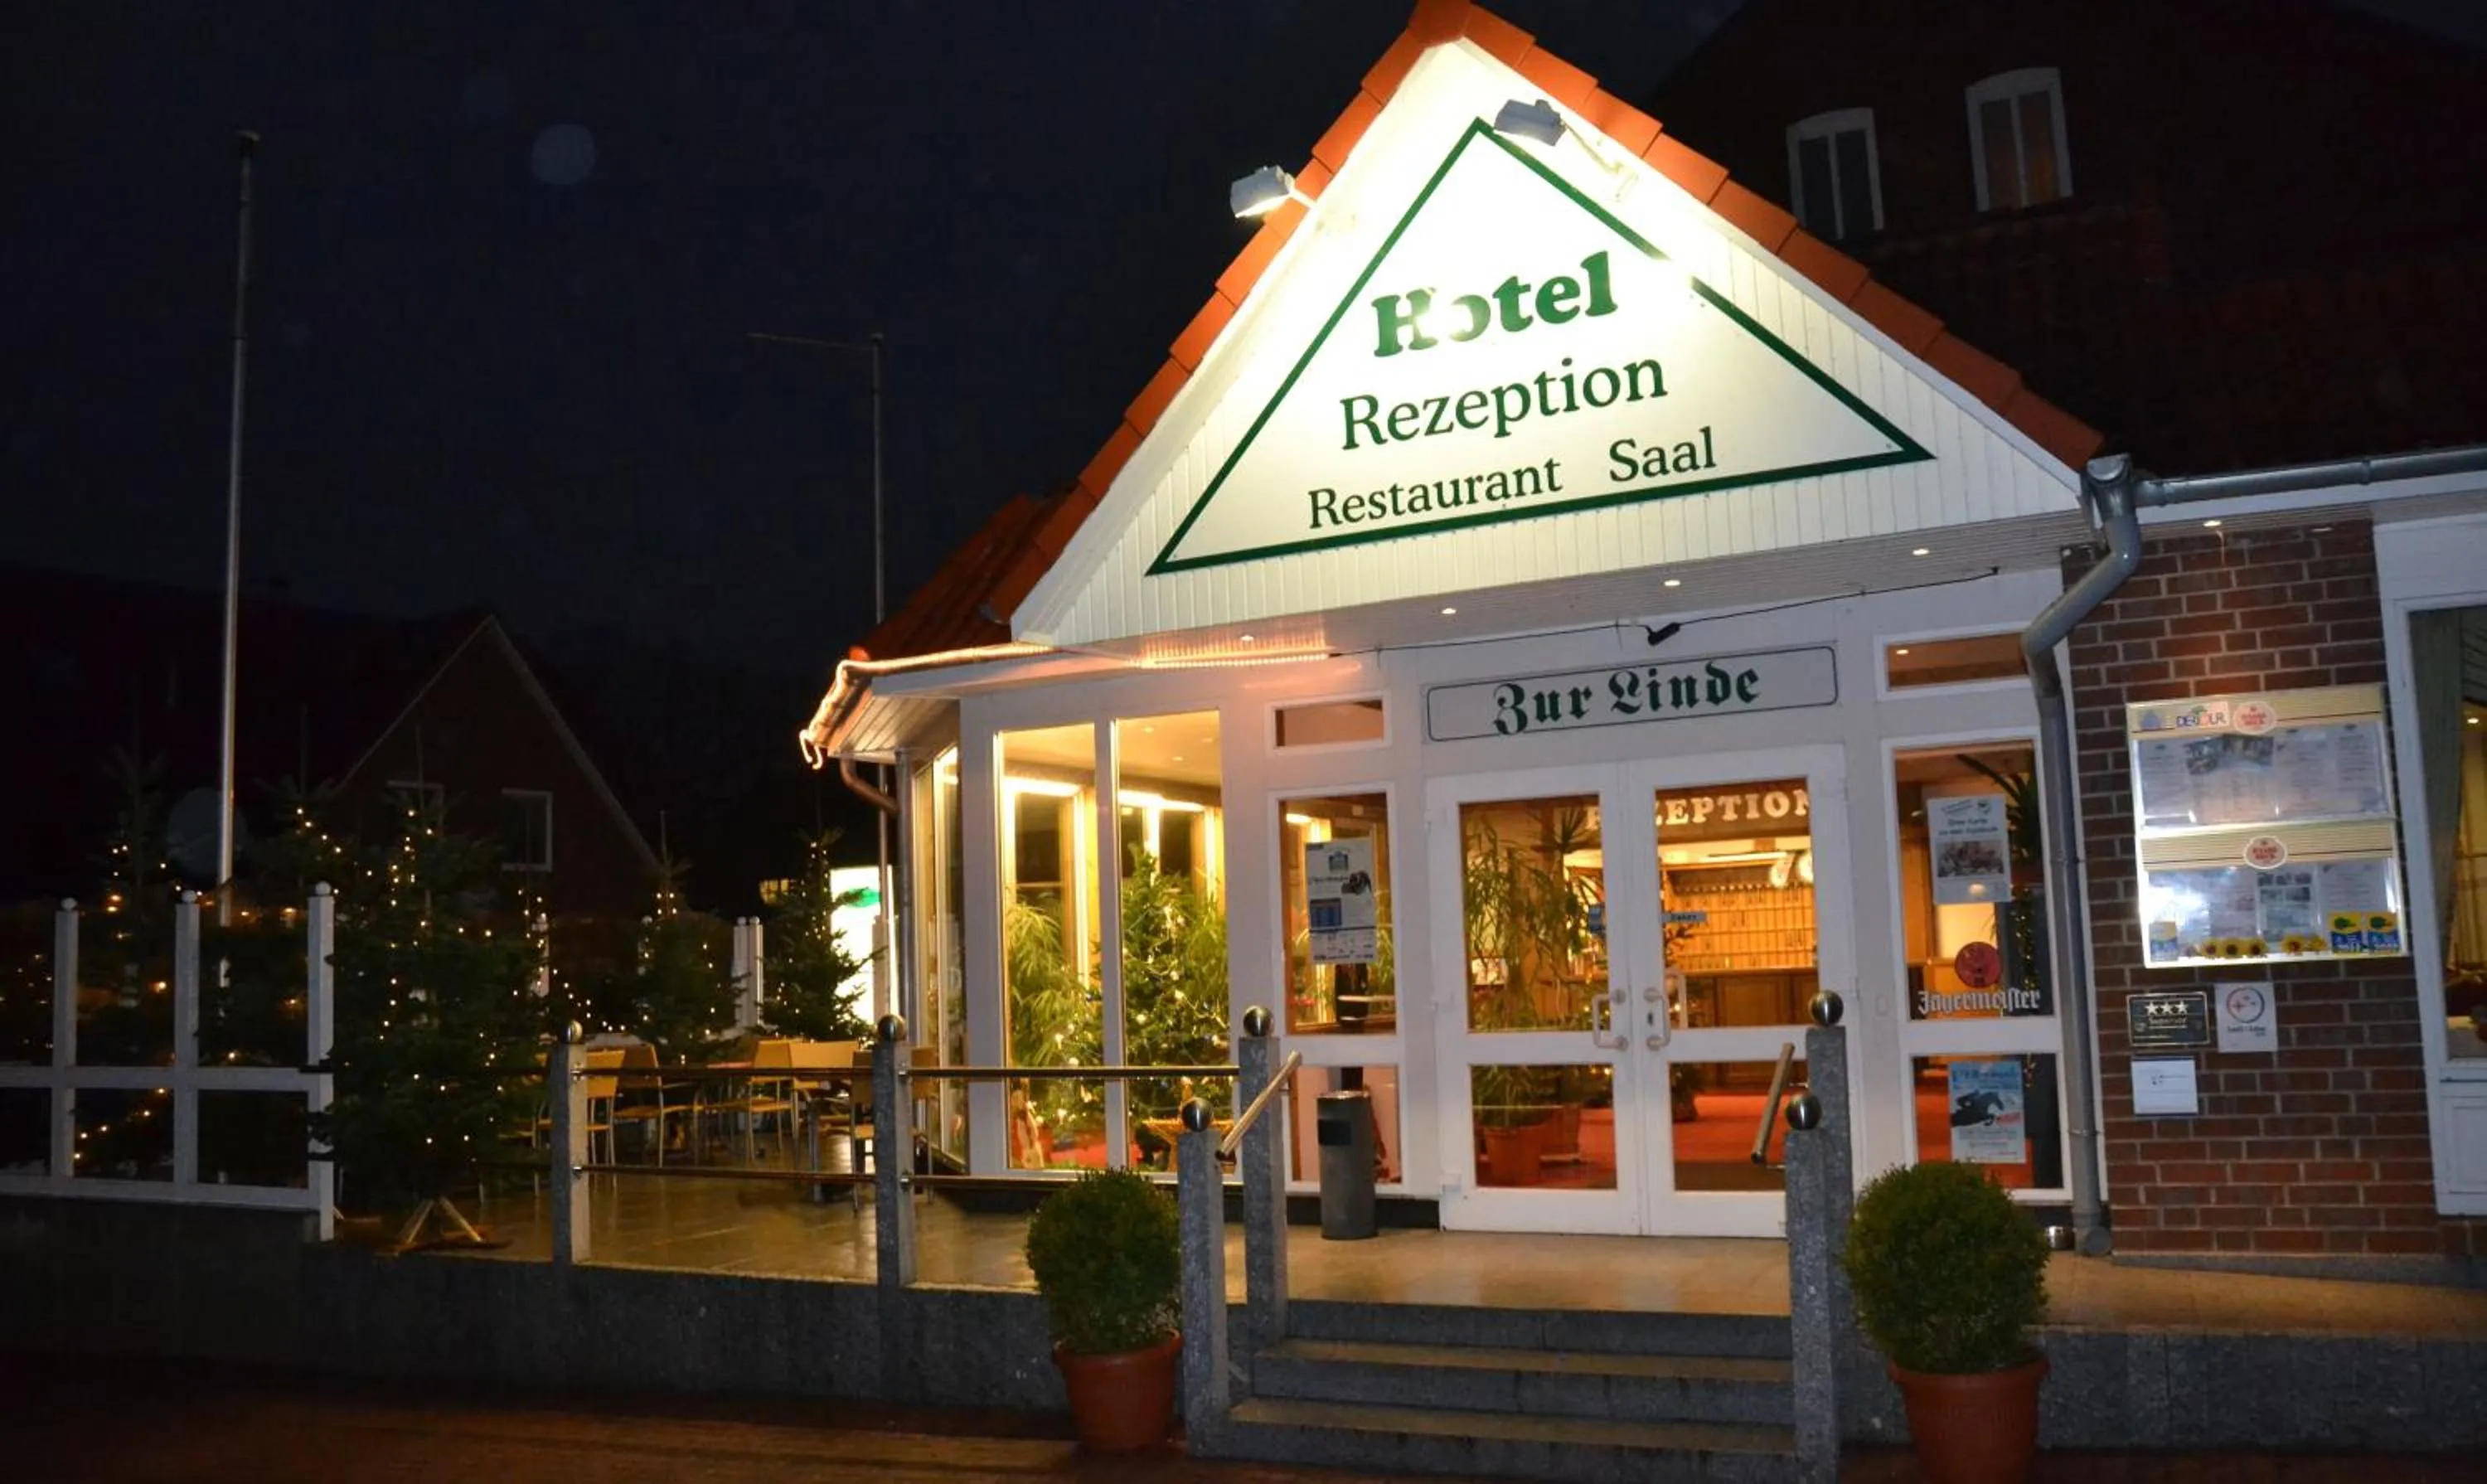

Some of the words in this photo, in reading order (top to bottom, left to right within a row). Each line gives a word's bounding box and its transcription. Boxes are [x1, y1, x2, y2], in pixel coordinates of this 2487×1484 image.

[1371, 250, 1618, 357] Hotel
[1340, 357, 1668, 450] Rezeption
[1307, 458, 1563, 530] Restaurant
[1608, 427, 1717, 483] Saal
[1493, 683, 1593, 735] Zur
[1608, 661, 1760, 715] Linde
